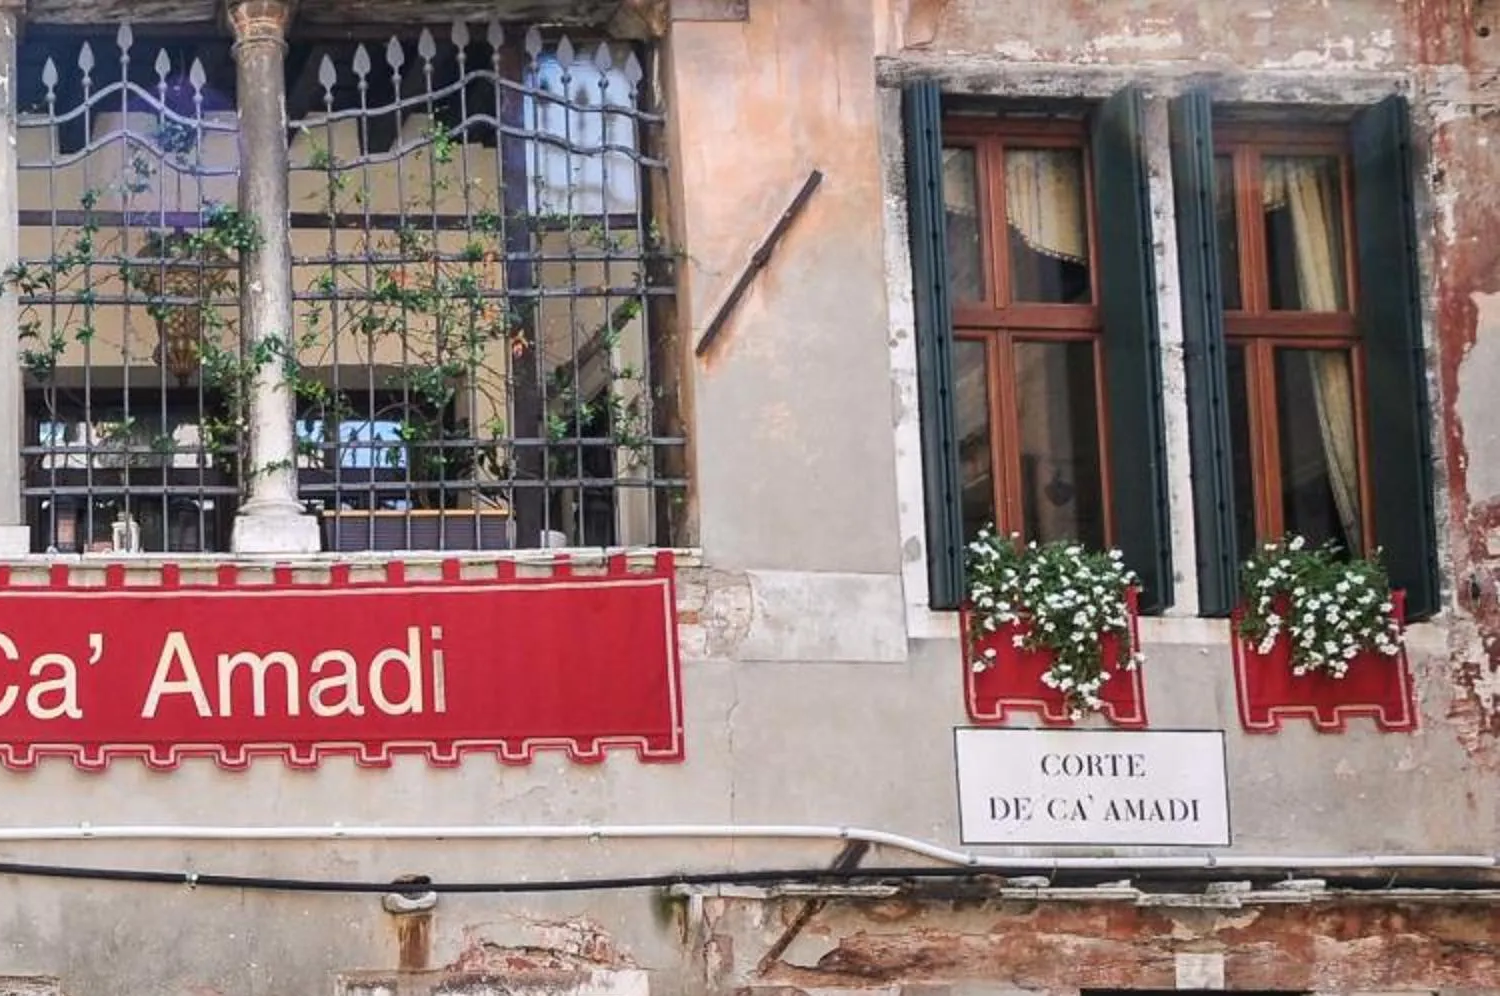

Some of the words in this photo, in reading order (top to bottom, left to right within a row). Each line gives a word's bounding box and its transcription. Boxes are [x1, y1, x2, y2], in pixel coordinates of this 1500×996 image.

[141, 626, 446, 718] Amadi
[1041, 753, 1146, 777] CORTE
[989, 797, 1032, 821] DE
[1104, 799, 1200, 822] AMADI
